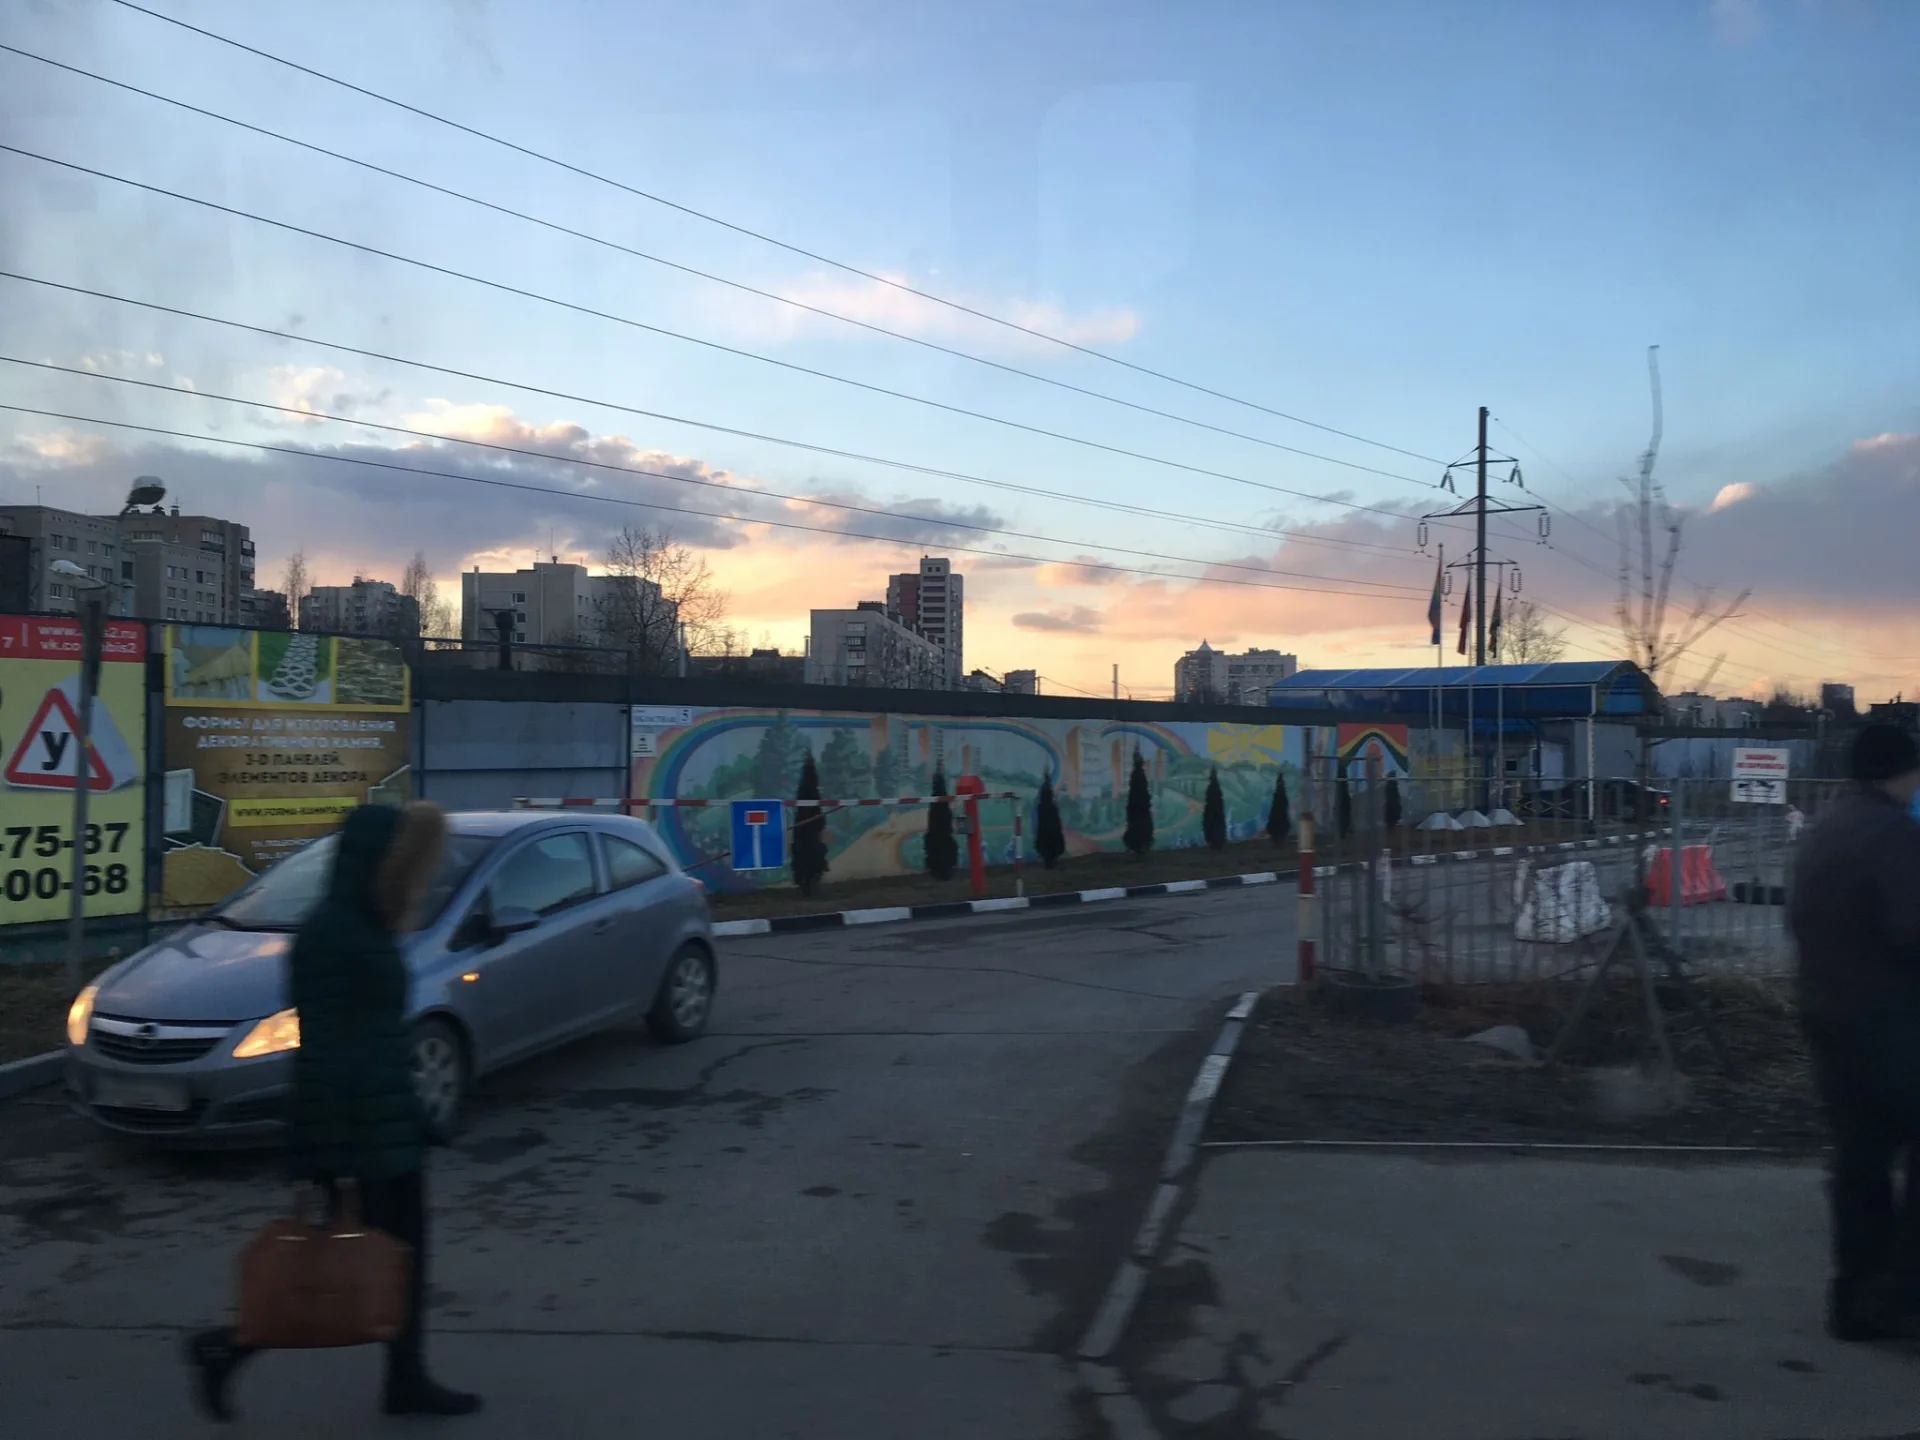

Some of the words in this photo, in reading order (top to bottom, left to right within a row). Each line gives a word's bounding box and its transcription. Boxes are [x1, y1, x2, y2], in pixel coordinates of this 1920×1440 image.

[182, 716, 248, 730] ФОРМЫ
[252, 717, 283, 731] ДЛЯ
[285, 718, 396, 733] ИЗГОТОВЛЕНИЯ
[197, 735, 329, 749] ДЕКОРАТИВНОГО
[40, 731, 70, 771] У
[217, 771, 309, 784] ЭЛЕМЕНТОВ
[312, 771, 369, 784] ДЕКОРА
